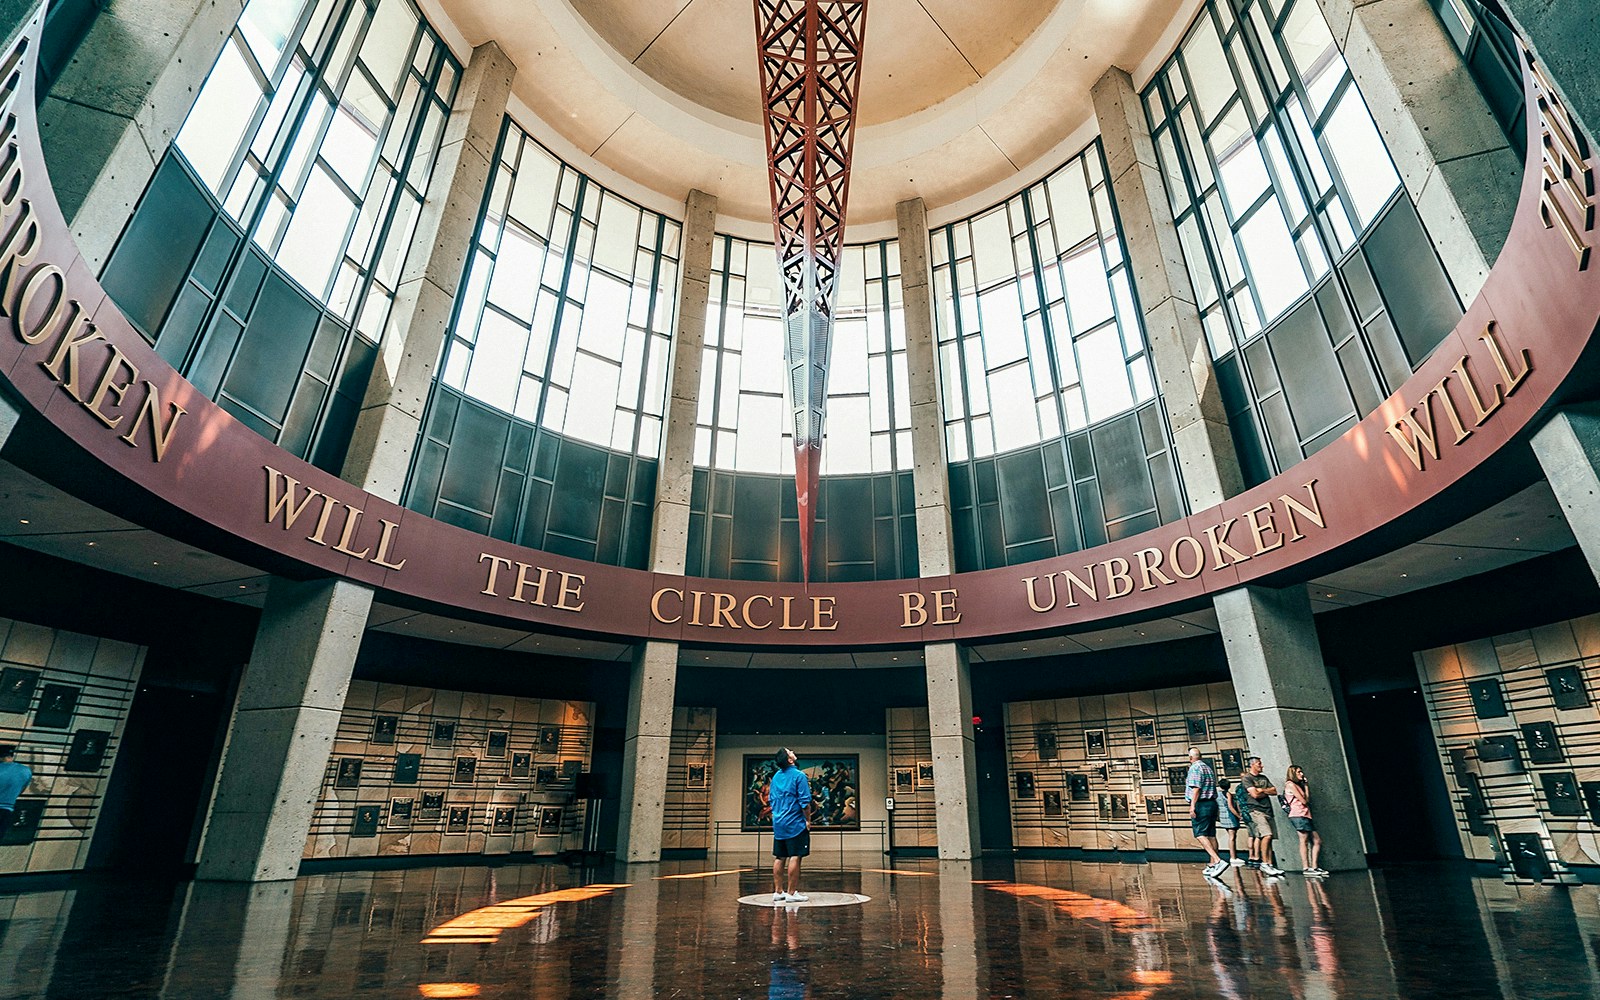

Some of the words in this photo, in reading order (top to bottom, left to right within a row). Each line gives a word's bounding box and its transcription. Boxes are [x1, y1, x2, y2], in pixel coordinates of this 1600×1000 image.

[264, 465, 407, 571] WILL
[478, 552, 587, 612] THE
[650, 587, 839, 631] CIRCLE
[898, 588, 962, 628] BE
[1021, 478, 1327, 613] UNBROKEN
[1385, 320, 1533, 472] WILL
